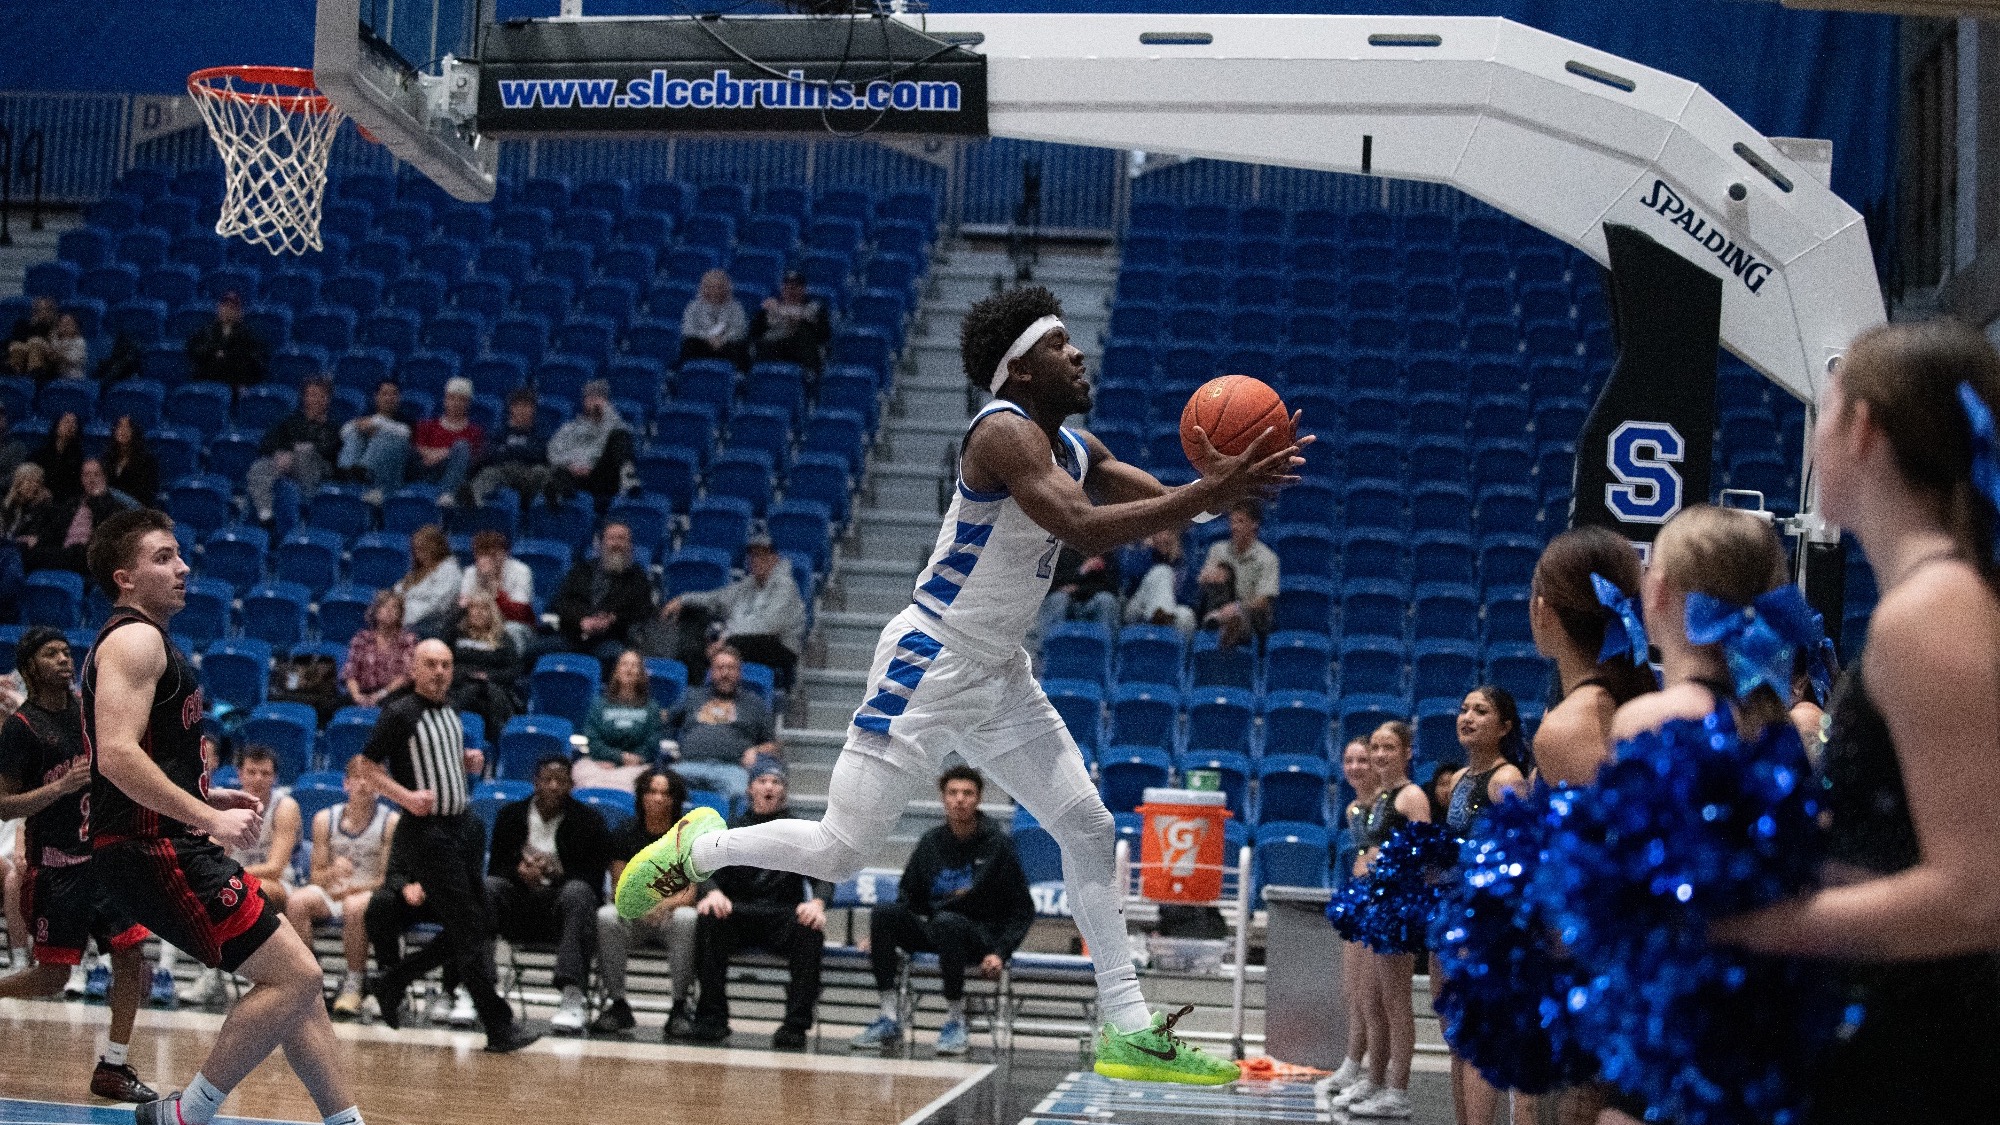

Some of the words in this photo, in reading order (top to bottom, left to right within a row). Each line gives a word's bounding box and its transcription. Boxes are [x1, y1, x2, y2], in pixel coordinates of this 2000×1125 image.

[498, 69, 962, 111] www.slccbruins.com
[1639, 179, 1773, 294] SPALDING
[1604, 420, 1685, 525] S
